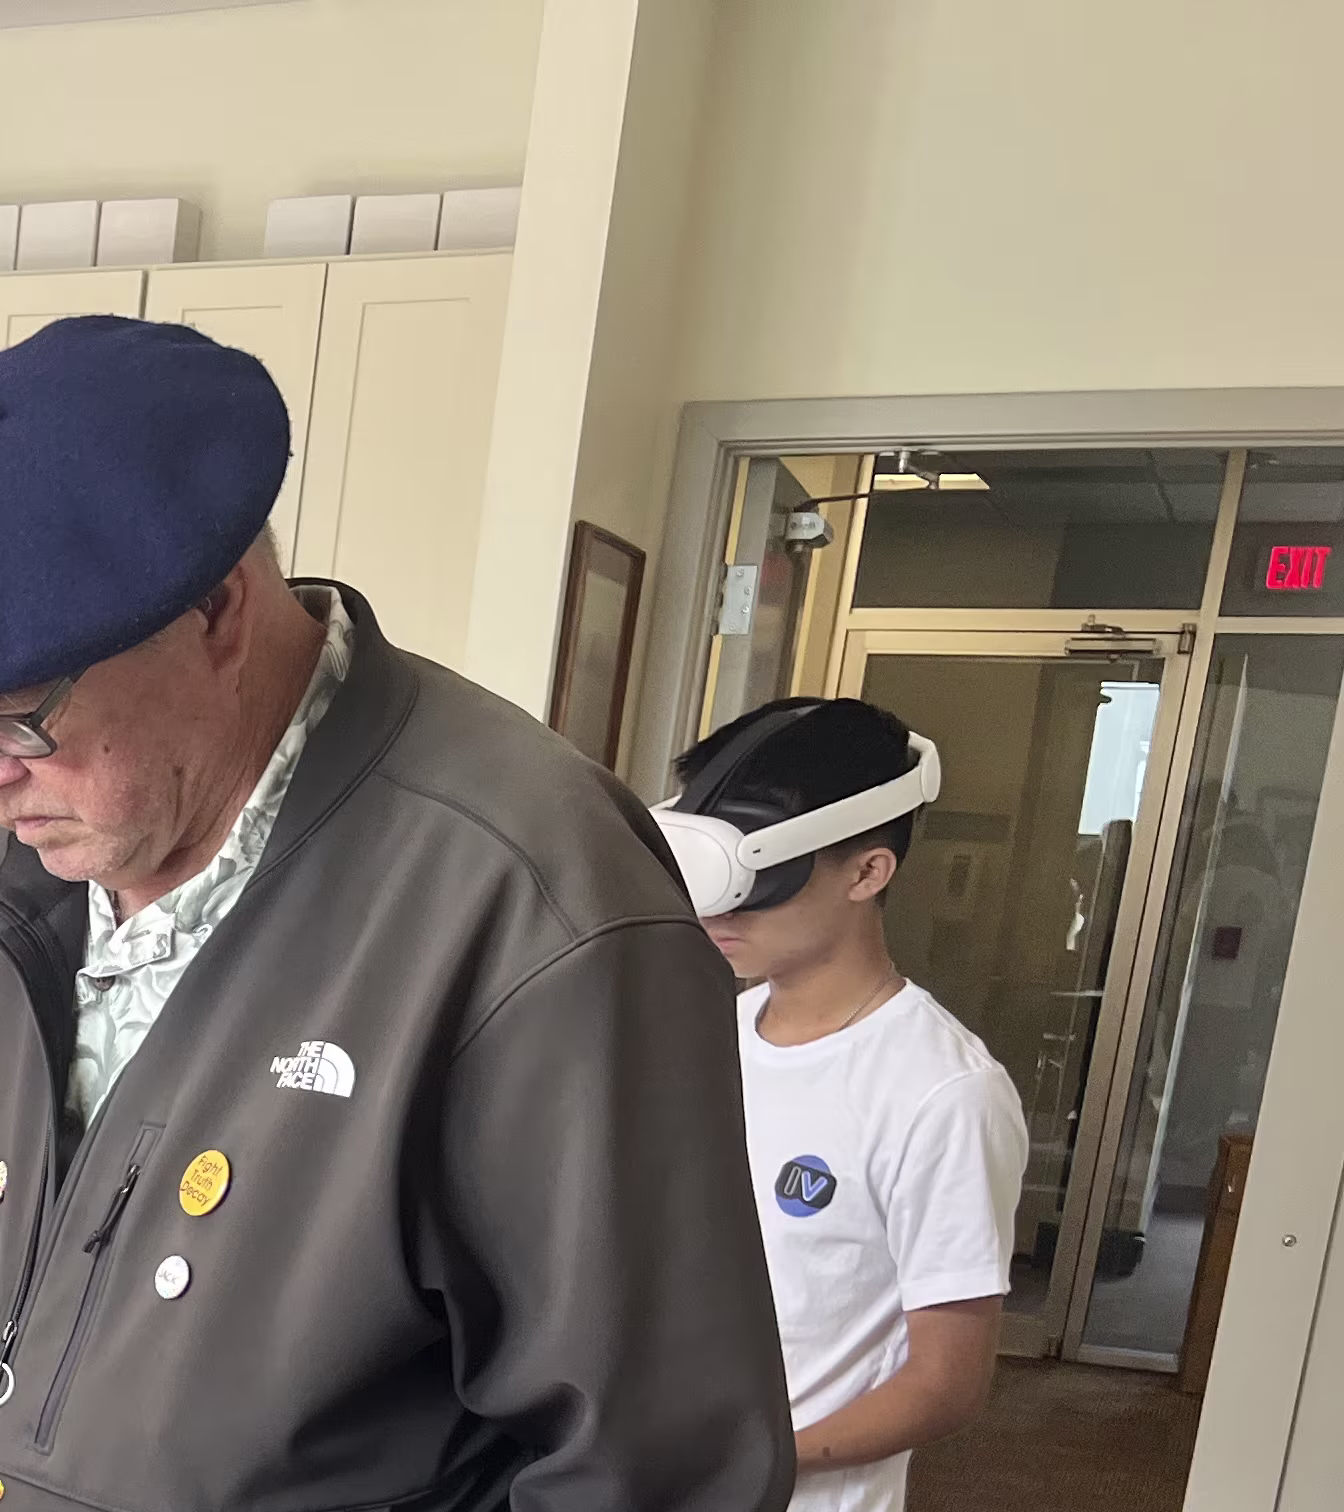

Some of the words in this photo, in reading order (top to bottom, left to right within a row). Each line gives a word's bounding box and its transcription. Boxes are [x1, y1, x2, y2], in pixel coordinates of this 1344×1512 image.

[1266, 546, 1331, 589] EXIT
[297, 1040, 324, 1058] THE
[270, 1056, 320, 1074] NORTH
[276, 1072, 316, 1091] FACE
[199, 1155, 223, 1176] Fight
[190, 1168, 213, 1191] Truth
[180, 1180, 212, 1207] Decay
